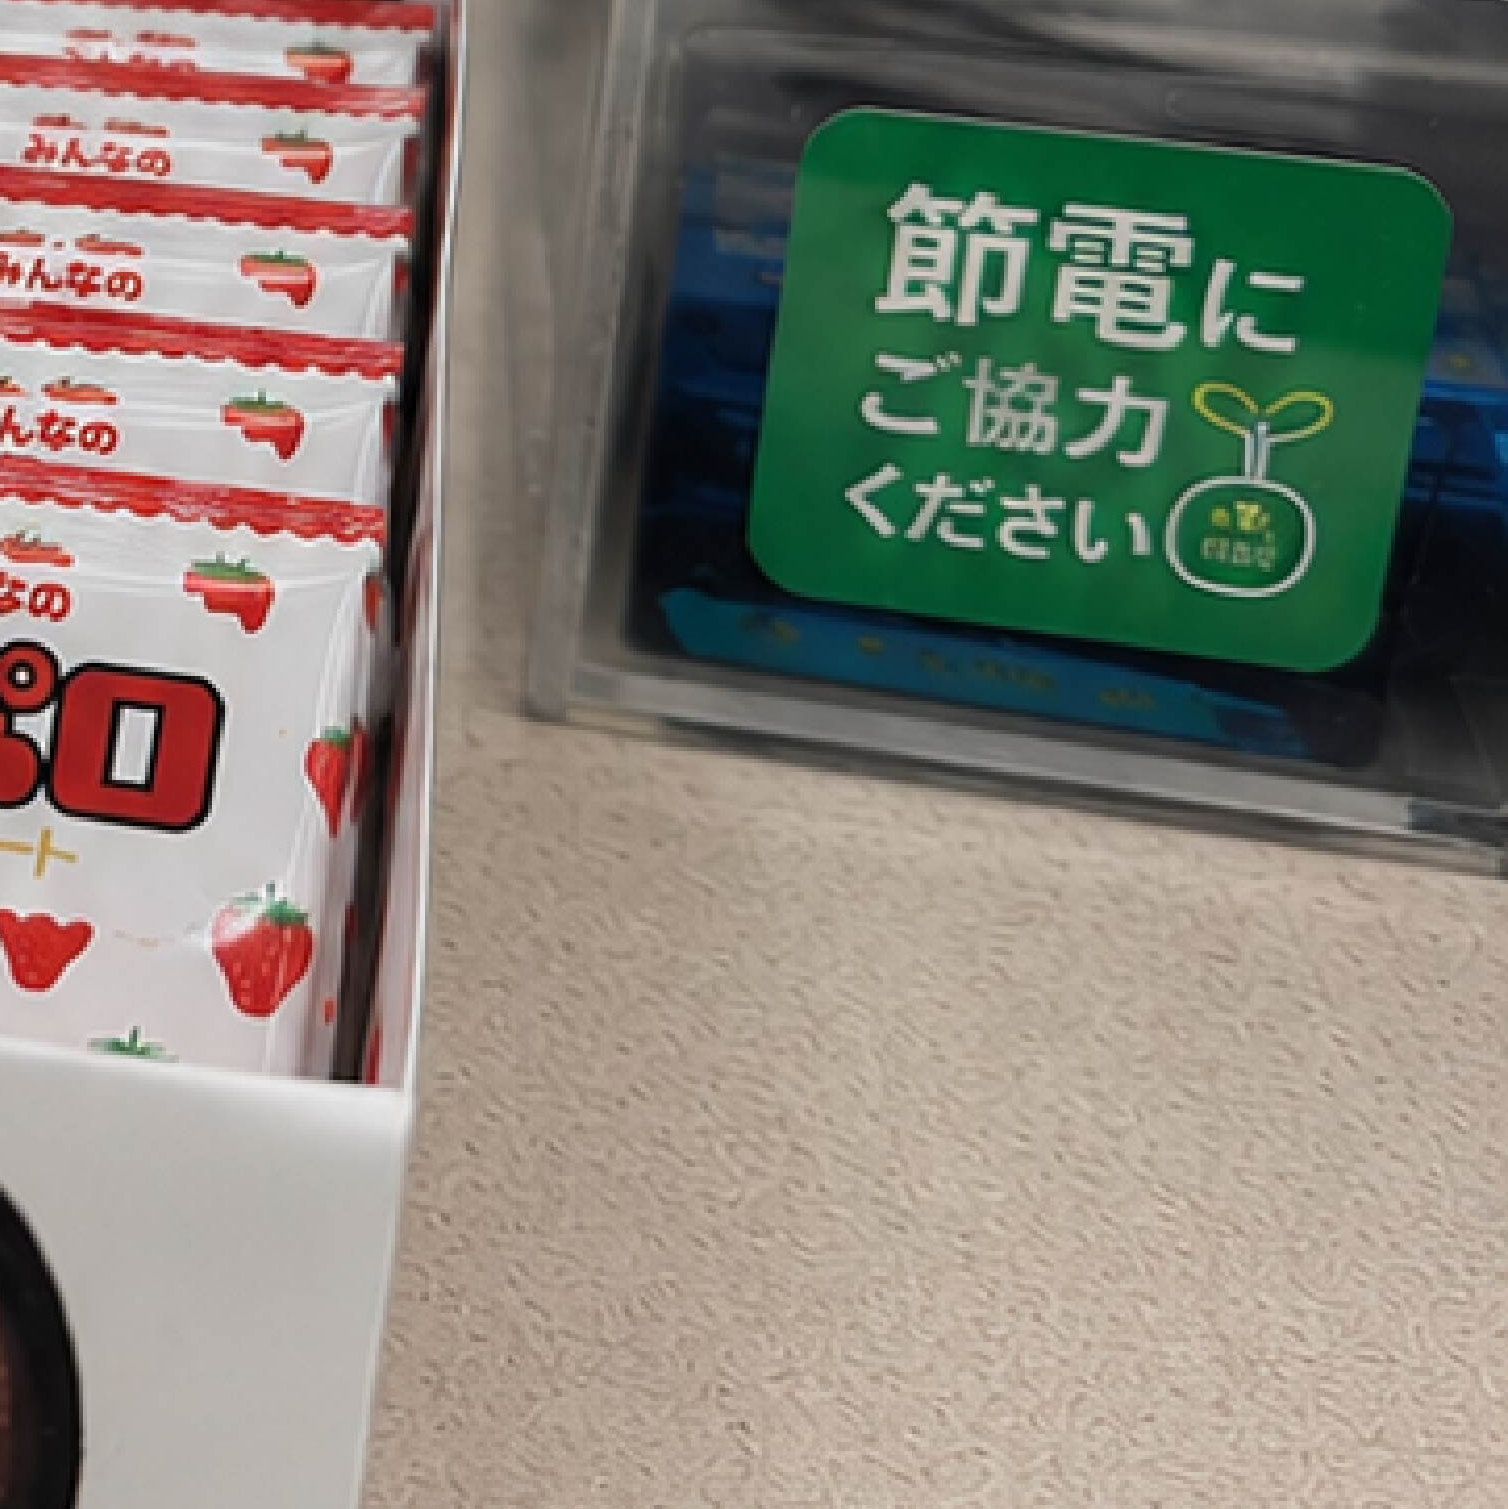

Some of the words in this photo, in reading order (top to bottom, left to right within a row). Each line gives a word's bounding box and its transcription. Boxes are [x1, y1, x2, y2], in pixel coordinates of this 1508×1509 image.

[876, 183, 1305, 358] 節電に
[859, 352, 1170, 468] ご協力
[844, 461, 1153, 566] ください
